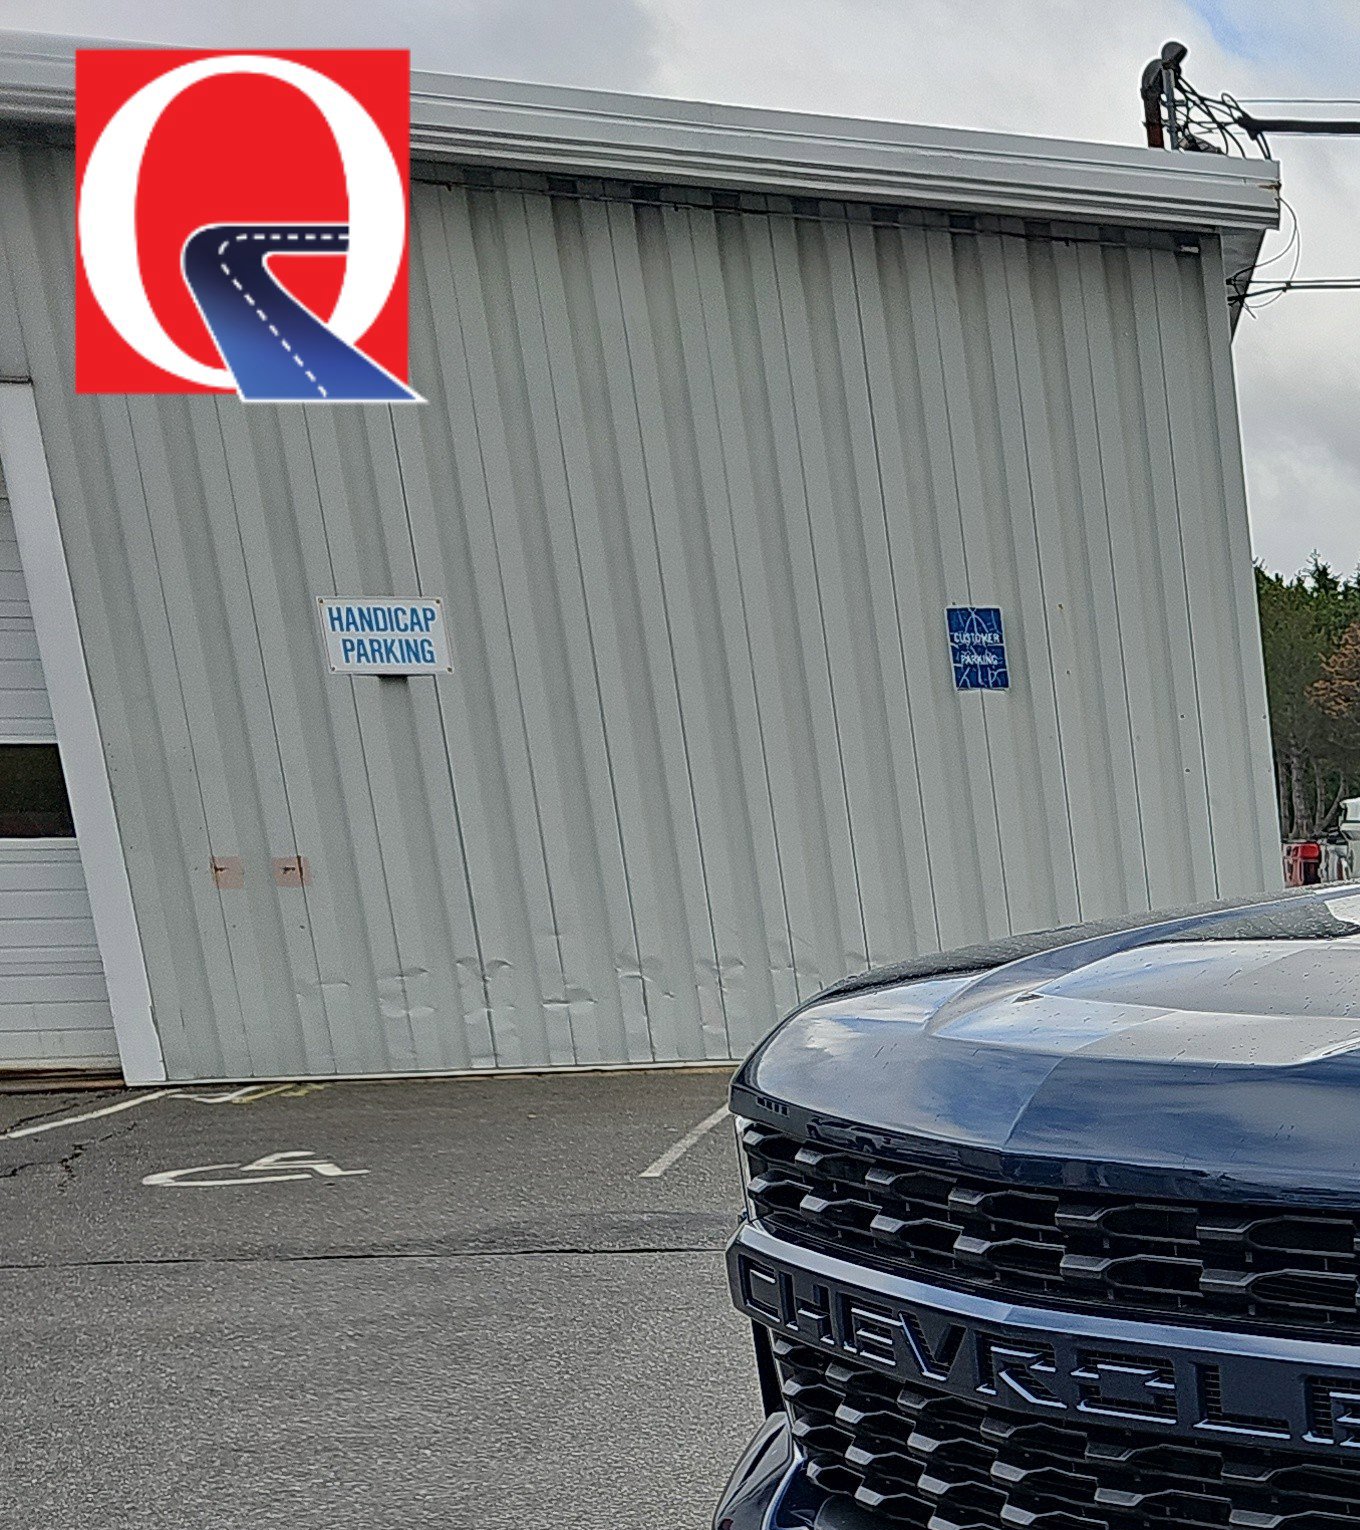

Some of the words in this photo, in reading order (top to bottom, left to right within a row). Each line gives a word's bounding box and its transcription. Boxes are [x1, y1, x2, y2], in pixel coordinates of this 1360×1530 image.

[327, 606, 436, 632] HANDICAP
[953, 632, 1000, 644] CUSTOMER
[341, 638, 436, 664] PARKING
[961, 654, 998, 666] PARKING
